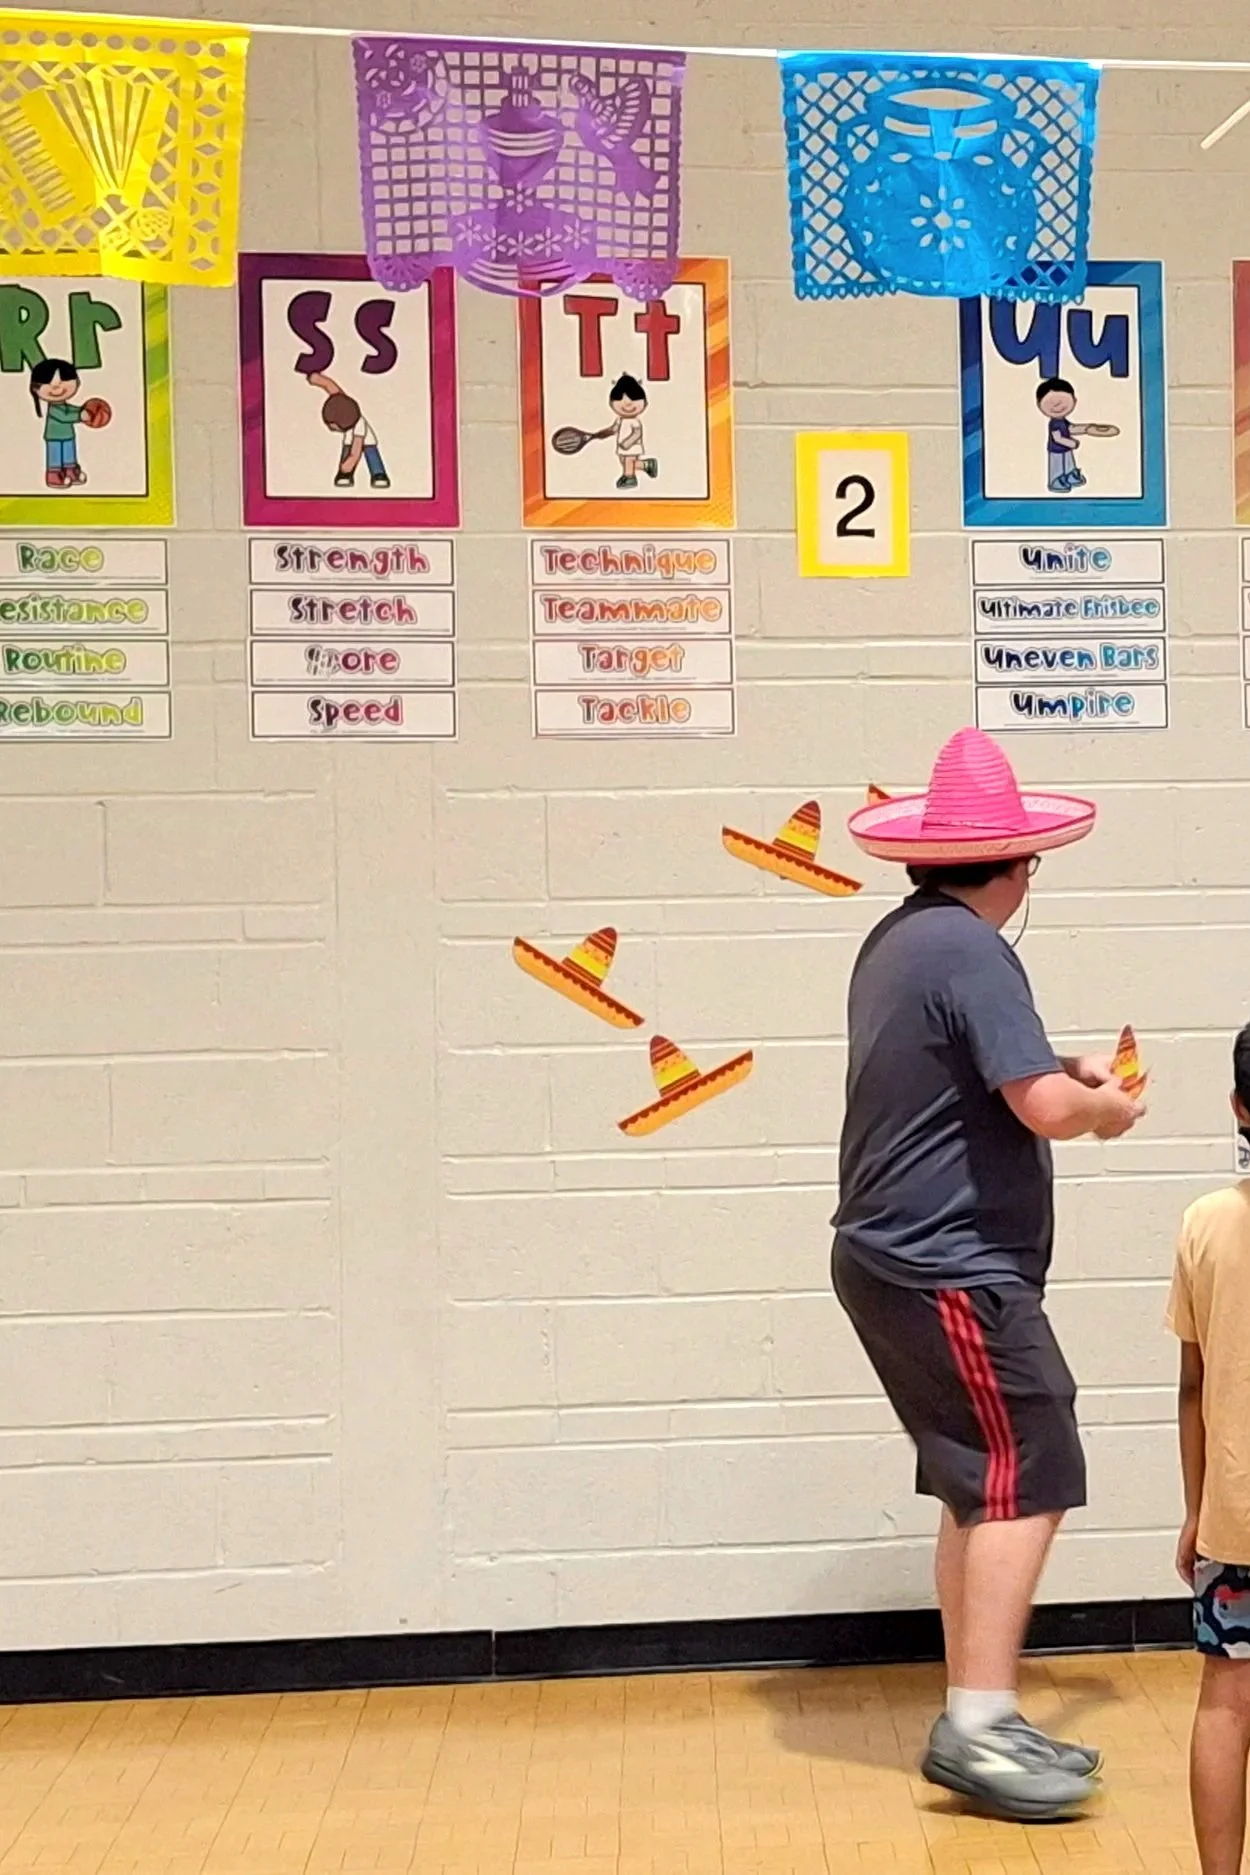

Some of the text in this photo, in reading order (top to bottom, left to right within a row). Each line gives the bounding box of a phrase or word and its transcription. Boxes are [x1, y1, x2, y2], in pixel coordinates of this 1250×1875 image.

[835, 475, 875, 538] 2
[18, 544, 103, 572] Race
[276, 544, 428, 578] Strength
[542, 545, 716, 578] Technique
[0, 594, 148, 623] esistance
[290, 595, 416, 623] Stretch
[542, 594, 721, 622] Teammate
[1081, 594, 1159, 618] Frisbee
[3, 642, 125, 674] Routine
[579, 644, 683, 677] Target
[1101, 644, 1158, 669] Bars
[308, 697, 402, 728] Speed
[579, 695, 690, 723] Tackle
